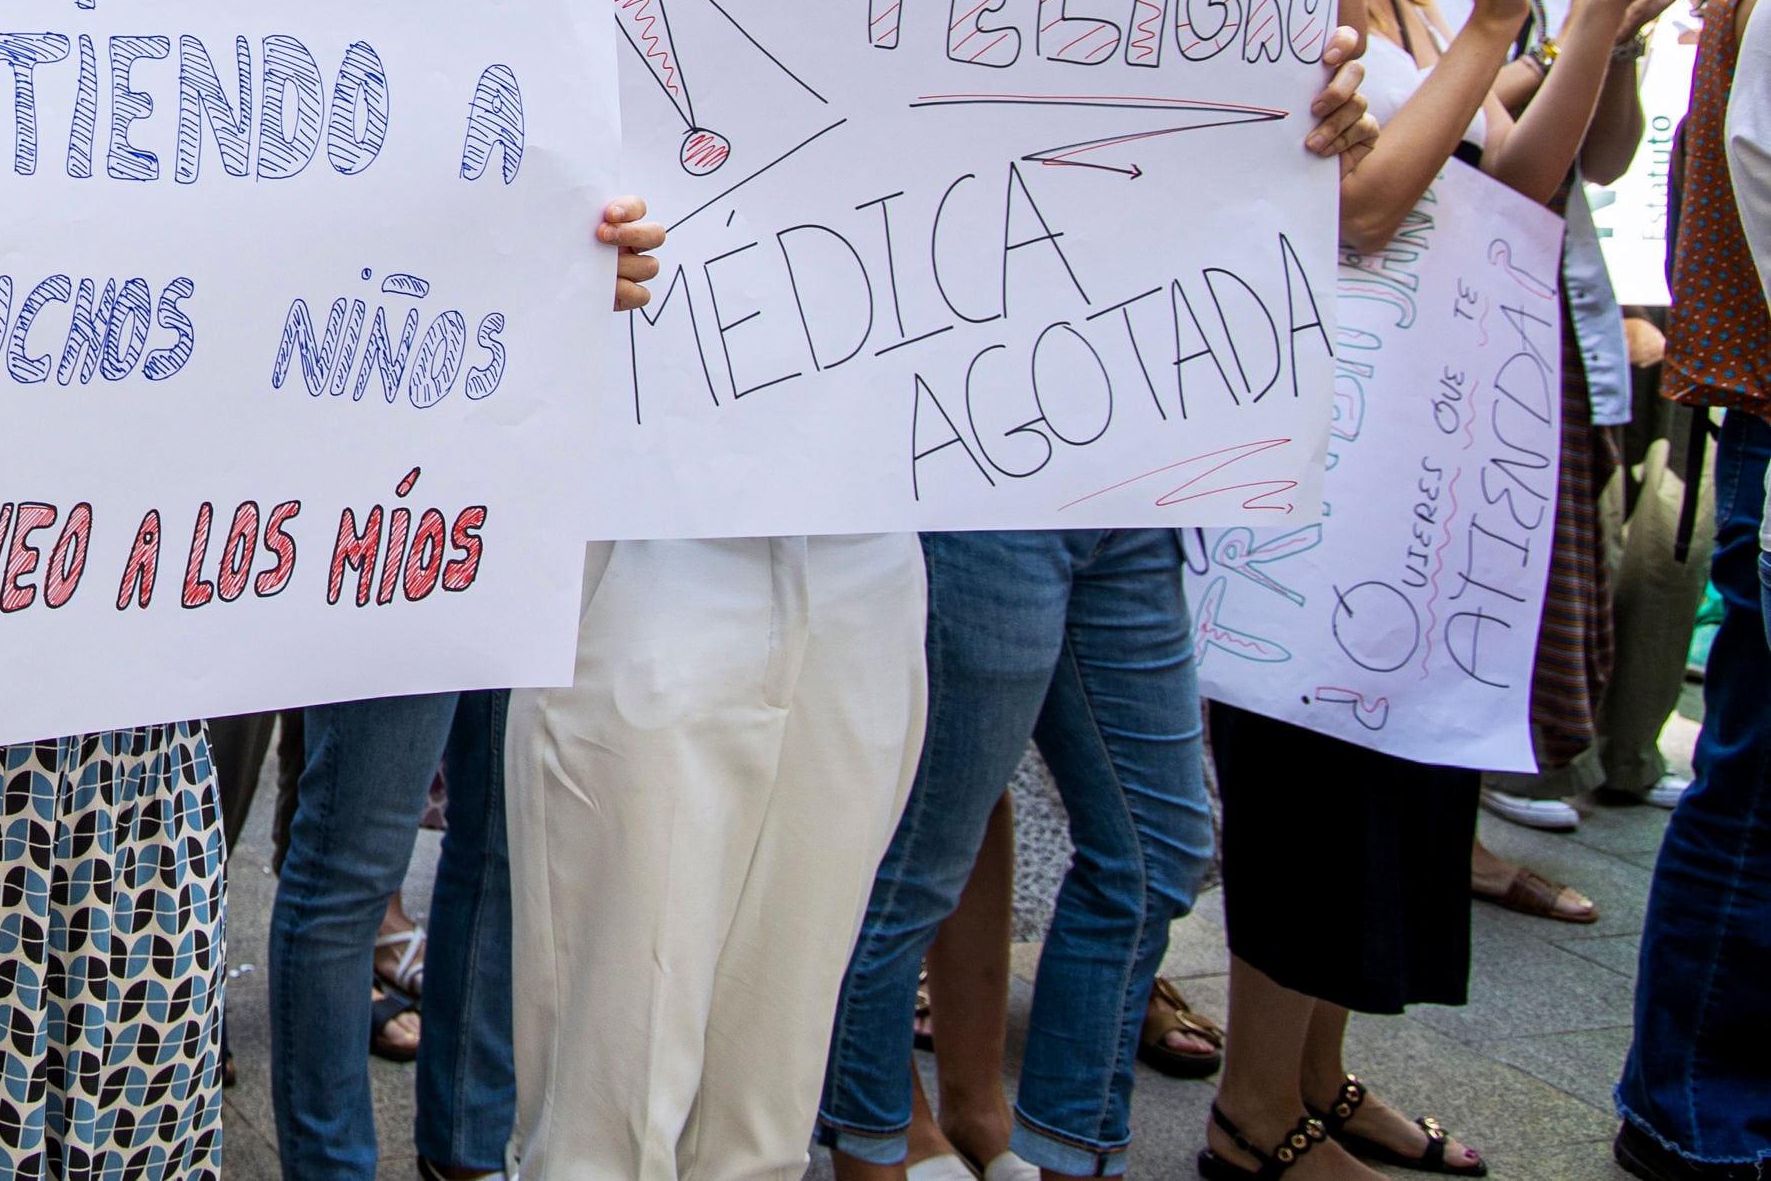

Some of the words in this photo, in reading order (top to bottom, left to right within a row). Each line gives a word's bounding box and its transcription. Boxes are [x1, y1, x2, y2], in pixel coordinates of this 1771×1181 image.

[459, 63, 526, 185] A
[629, 162, 1091, 425] MÉDICA
[912, 232, 1334, 502] AGOTADA
[1430, 363, 1466, 435] QUE
[1452, 278, 1480, 322] TE
[116, 509, 162, 612] A
[180, 500, 301, 610] LOS
[325, 466, 488, 609] MÍOS
